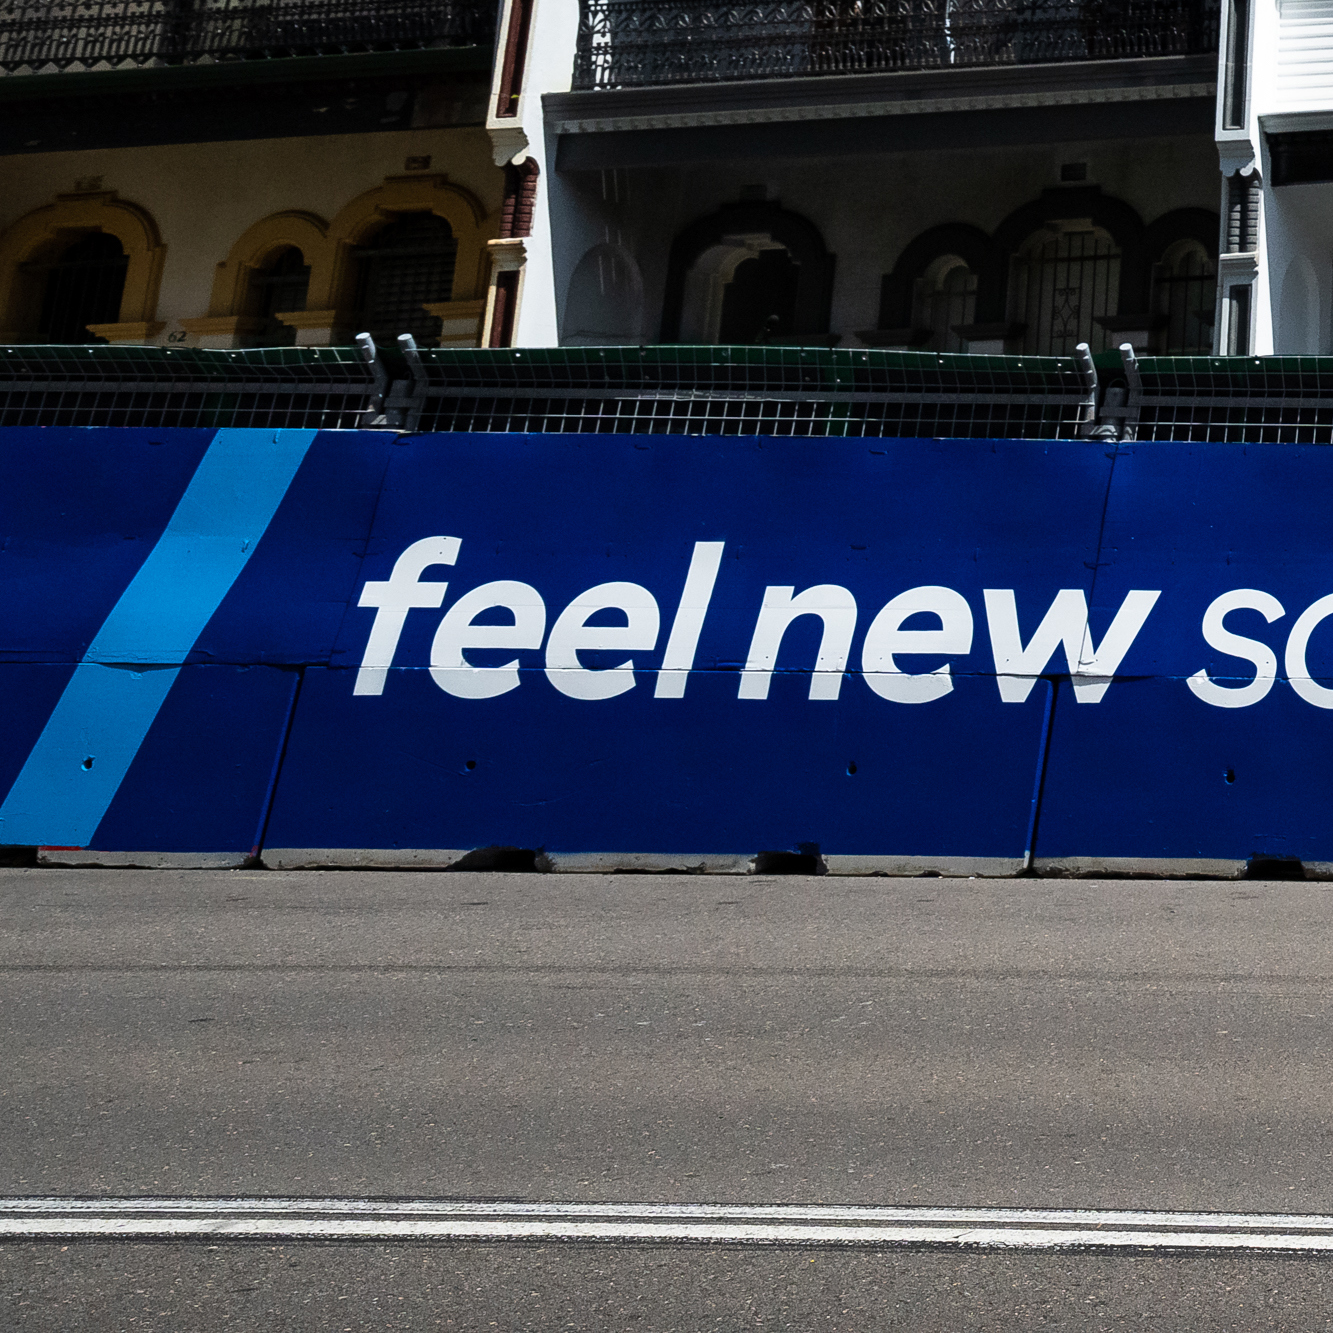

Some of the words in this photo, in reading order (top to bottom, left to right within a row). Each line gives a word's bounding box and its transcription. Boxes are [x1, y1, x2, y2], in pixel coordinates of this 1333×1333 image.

[168, 331, 187, 343] 62
[353, 536, 725, 701] feel
[737, 584, 1162, 705] new
